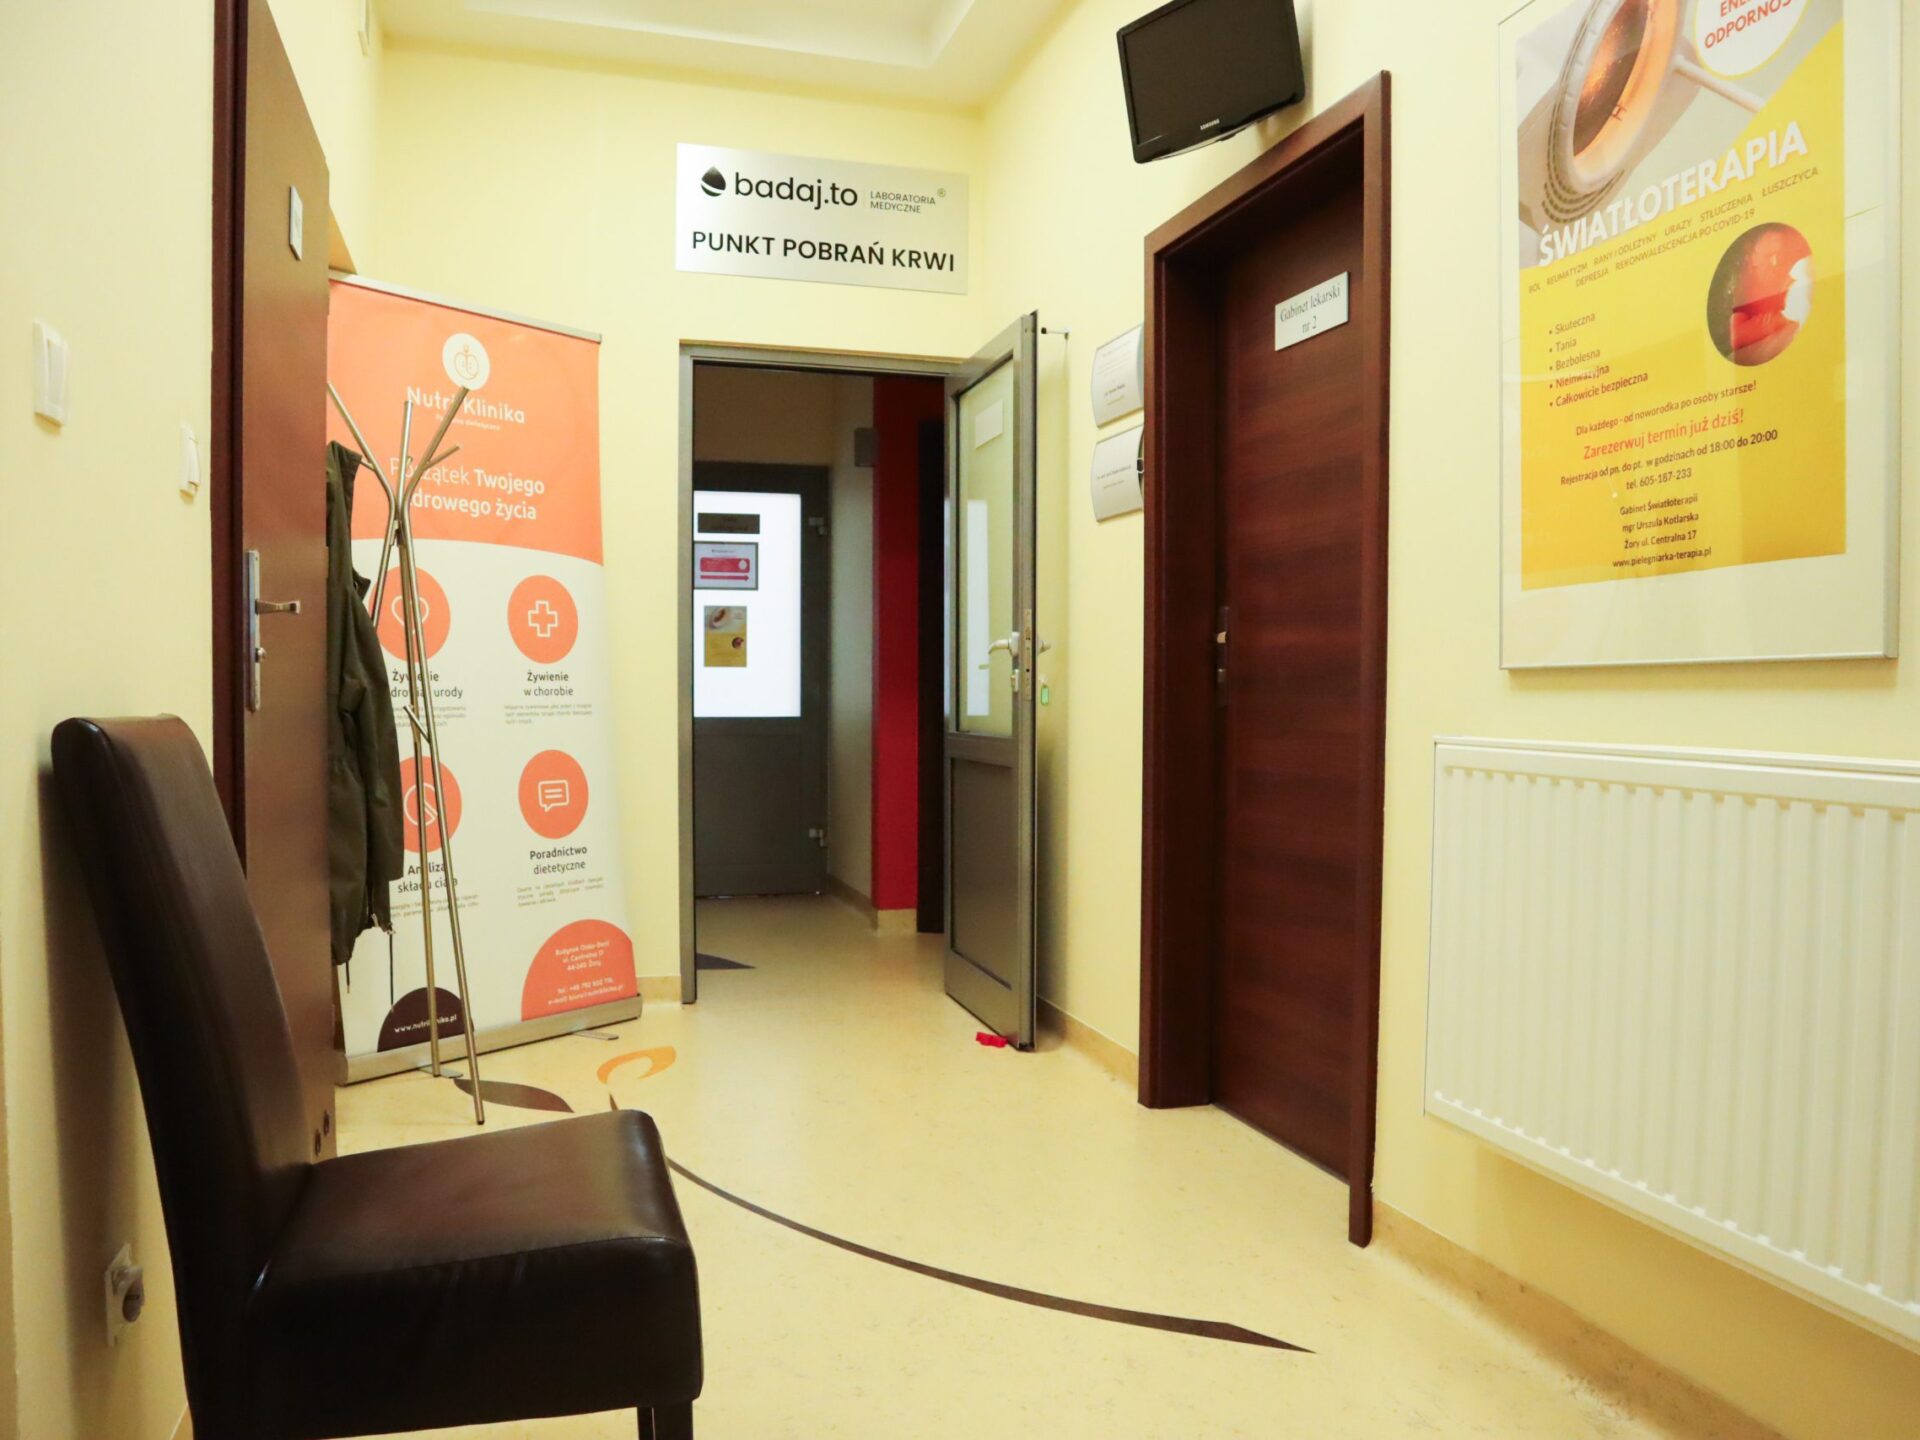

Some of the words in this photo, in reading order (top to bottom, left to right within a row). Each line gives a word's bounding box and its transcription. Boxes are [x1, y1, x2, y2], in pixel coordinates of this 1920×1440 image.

[735, 172, 858, 210] badaj.to
[870, 190, 936, 205] LABORATORIA
[1538, 120, 1808, 267] ŚWIATŁOTERAPIA
[870, 201, 921, 214] MEDYCZNE
[1546, 262, 1588, 286] REUMATYZM
[1593, 252, 1613, 265] RANY
[1665, 217, 1692, 236] URAZY
[1700, 194, 1754, 222] STŁUCZENIA
[1762, 167, 1819, 197] ŁUSZCZYCA
[692, 231, 775, 255] PUNKT
[783, 239, 884, 265] POBRAŃ
[892, 248, 954, 272] KRWI
[1575, 267, 1609, 288] DEPRESJA
[1615, 229, 1699, 271] REKONWALESCENCJA
[1699, 225, 1712, 238] PO
[1712, 208, 1756, 233] COVID-19
[1280, 301, 1308, 322] Gabinet
[1310, 283, 1340, 309] lekarski
[1302, 322, 1310, 334] nr
[1312, 315, 1317, 329] 2
[1555, 312, 1596, 335] Skuteczna
[1555, 337, 1577, 352] Tania
[1555, 348, 1601, 370] Bezbolesna
[1555, 364, 1610, 389] Nieinwazyjna
[1556, 384, 1600, 407] Całkowicie
[1601, 372, 1649, 393] bezpieczna
[463, 397, 525, 424] Klinika
[1575, 425, 1588, 436] Dla
[1588, 418, 1618, 434] każdego
[1623, 413, 1633, 423] od
[1635, 402, 1679, 420] noworodka
[1680, 398, 1692, 410] po
[1693, 392, 1719, 406] osoby
[1720, 380, 1757, 399] starsze!
[1583, 435, 1645, 460] Zarezerwuj
[1647, 424, 1687, 444] termin
[1688, 416, 1709, 438] już
[1711, 408, 1744, 429] dziś!
[1560, 470, 1598, 486] Rejestracja
[1599, 467, 1609, 477] od
[1609, 465, 1620, 478] pn.
[1621, 462, 1632, 472] do
[1632, 459, 1643, 473] pt.
[1646, 459, 1654, 467] w
[1654, 449, 1695, 468] godzinach
[1696, 444, 1707, 455] od
[1709, 438, 1735, 453] 18:00
[1736, 436, 1748, 447] do
[1750, 429, 1778, 444] 20:00
[389, 457, 470, 486] Pozątek
[473, 468, 545, 497] Twojego
[1626, 480, 1638, 490] tel.
[1639, 467, 1692, 487] 605-187-233
[408, 487, 491, 517] drowego
[495, 498, 537, 521] życia
[1620, 503, 1646, 515] Gabinet
[1647, 493, 1698, 512] Światłoterapii
[1622, 524, 1635, 533] mgr
[1636, 517, 1662, 530] Urszula
[1663, 512, 1699, 526] Kotlarska
[1624, 538, 1640, 549] Żory
[1641, 537, 1649, 547] ul.
[1651, 532, 1686, 545] Centralna
[1687, 530, 1697, 540] 17
[1612, 546, 1712, 567] www.pielegniarka-terapia.pl
[527, 670, 569, 683] Żywienie
[434, 687, 463, 699] urody
[533, 685, 574, 697] chorobie
[529, 845, 588, 860] Poradnictwo
[407, 861, 446, 876] Anliza
[533, 860, 587, 875] dietetyczne
[434, 877, 458, 888] ciaa
